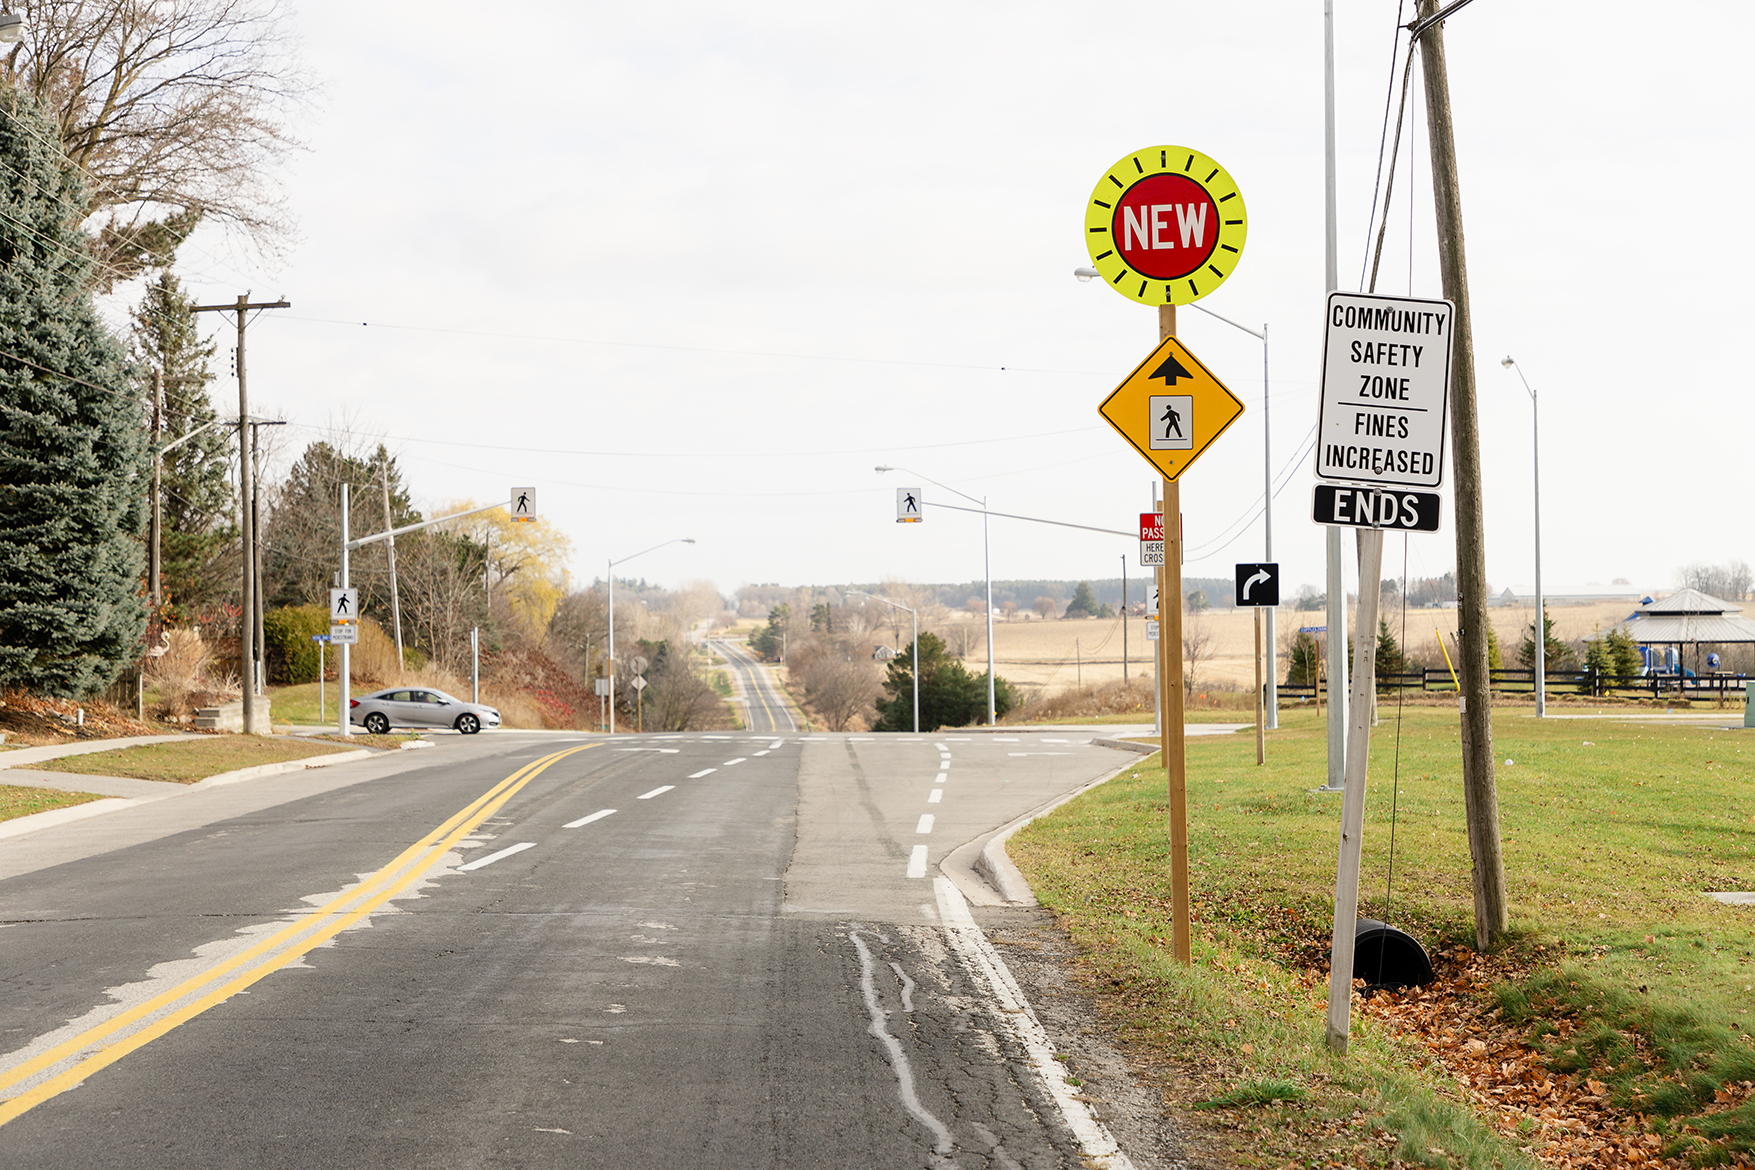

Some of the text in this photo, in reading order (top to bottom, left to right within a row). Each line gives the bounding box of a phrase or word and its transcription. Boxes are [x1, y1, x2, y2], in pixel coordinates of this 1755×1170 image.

[1123, 202, 1208, 251] NEW
[1332, 304, 1446, 336] COMMUNITY
[1350, 340, 1424, 368] SAFETY
[1359, 374, 1410, 401] ZONE
[1354, 412, 1409, 439] FINES
[1325, 443, 1434, 476] INCREASED
[1333, 488, 1420, 528] ENDS
[1142, 527, 1164, 539] PASS
[1143, 553, 1164, 563] CROS
